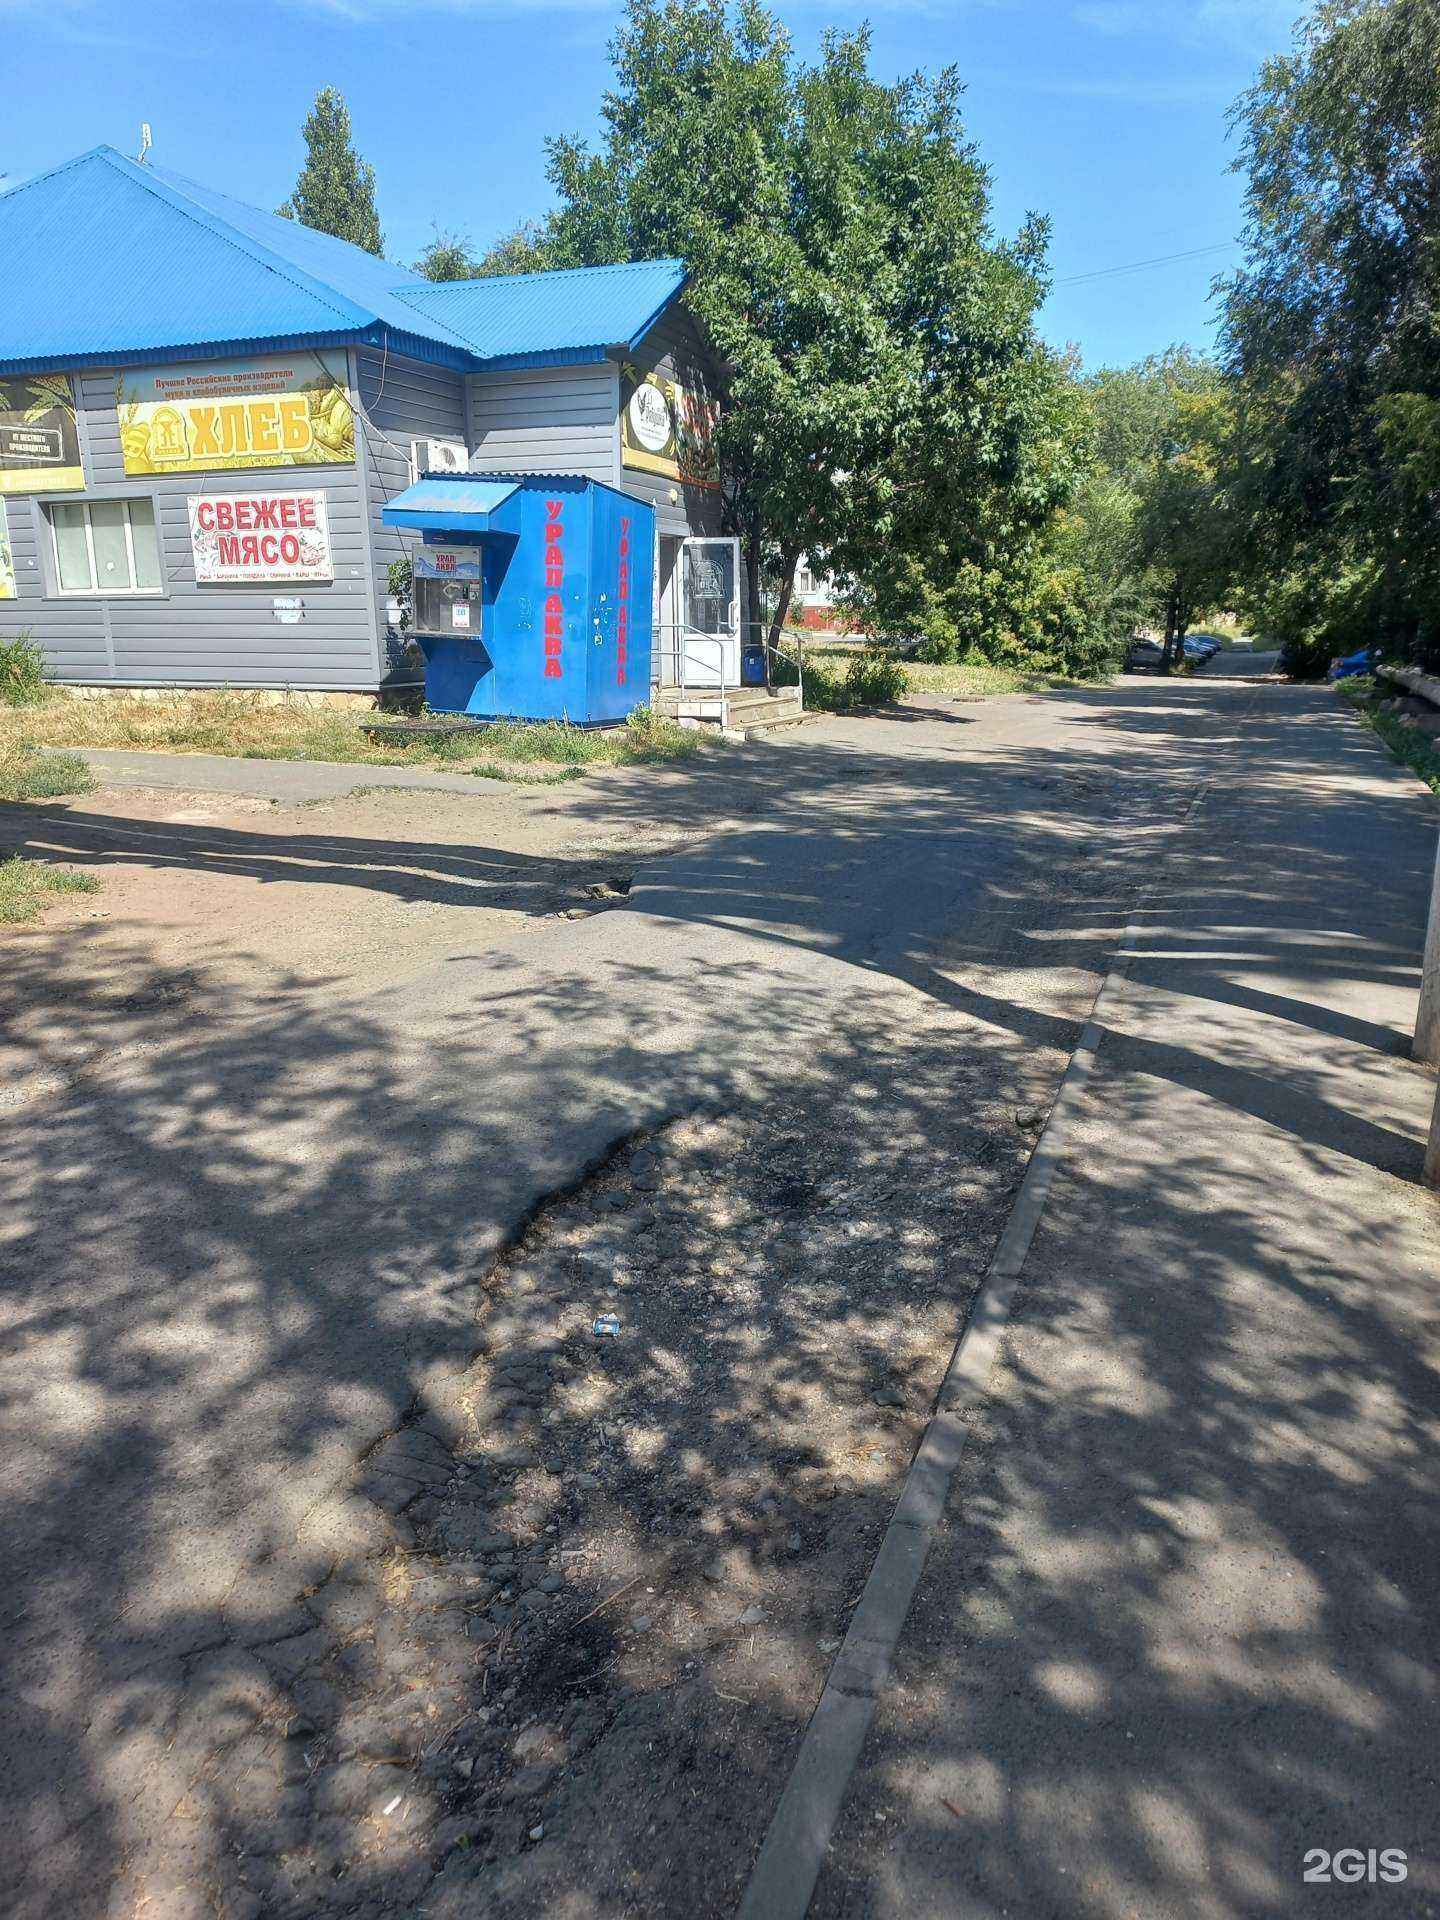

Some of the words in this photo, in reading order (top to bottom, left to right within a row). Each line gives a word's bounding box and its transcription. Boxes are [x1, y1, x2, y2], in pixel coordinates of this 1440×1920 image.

[186, 374, 232, 385] Российские
[233, 369, 293, 383] производители
[189, 400, 311, 455] ХЛЕБ
[197, 498, 316, 531] СВЕЖЕЕ
[217, 534, 300, 565] МЯСО
[544, 593, 563, 678] АКВА
[617, 605, 628, 687] АКВА
